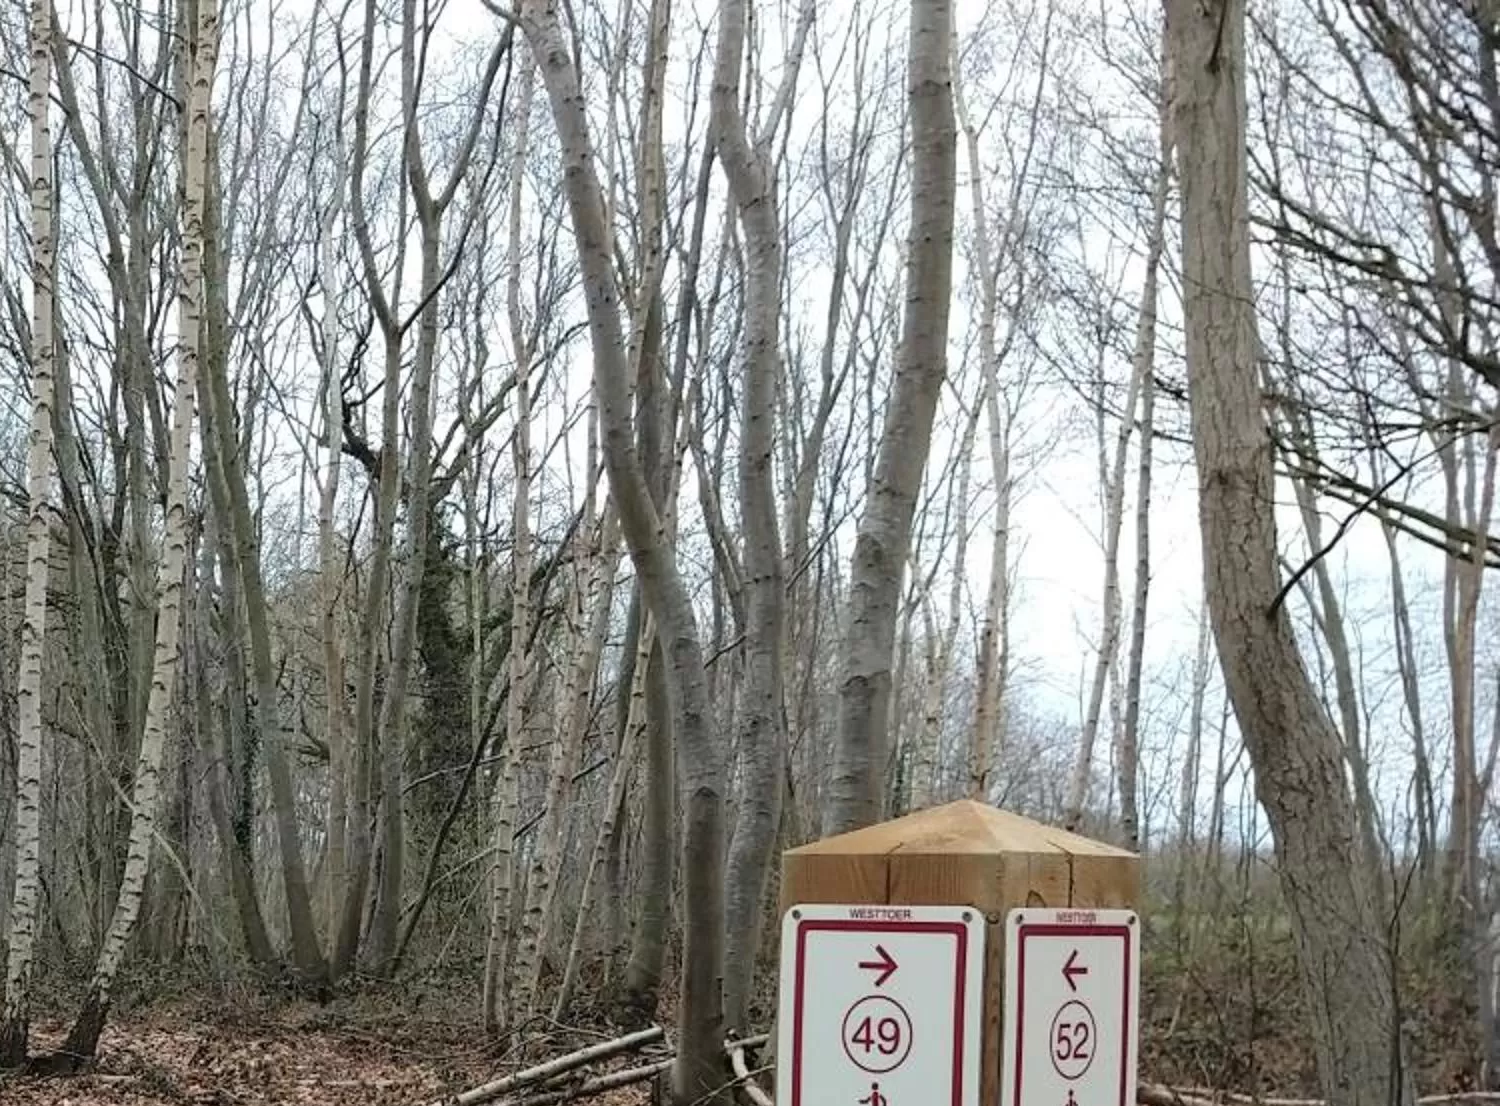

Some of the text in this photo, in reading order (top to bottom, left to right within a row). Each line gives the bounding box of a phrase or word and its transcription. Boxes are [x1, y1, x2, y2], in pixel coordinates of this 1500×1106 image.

[849, 907, 912, 919] WESTTOER
[852, 1017, 901, 1054] 49
[1056, 1023, 1089, 1061] 52
